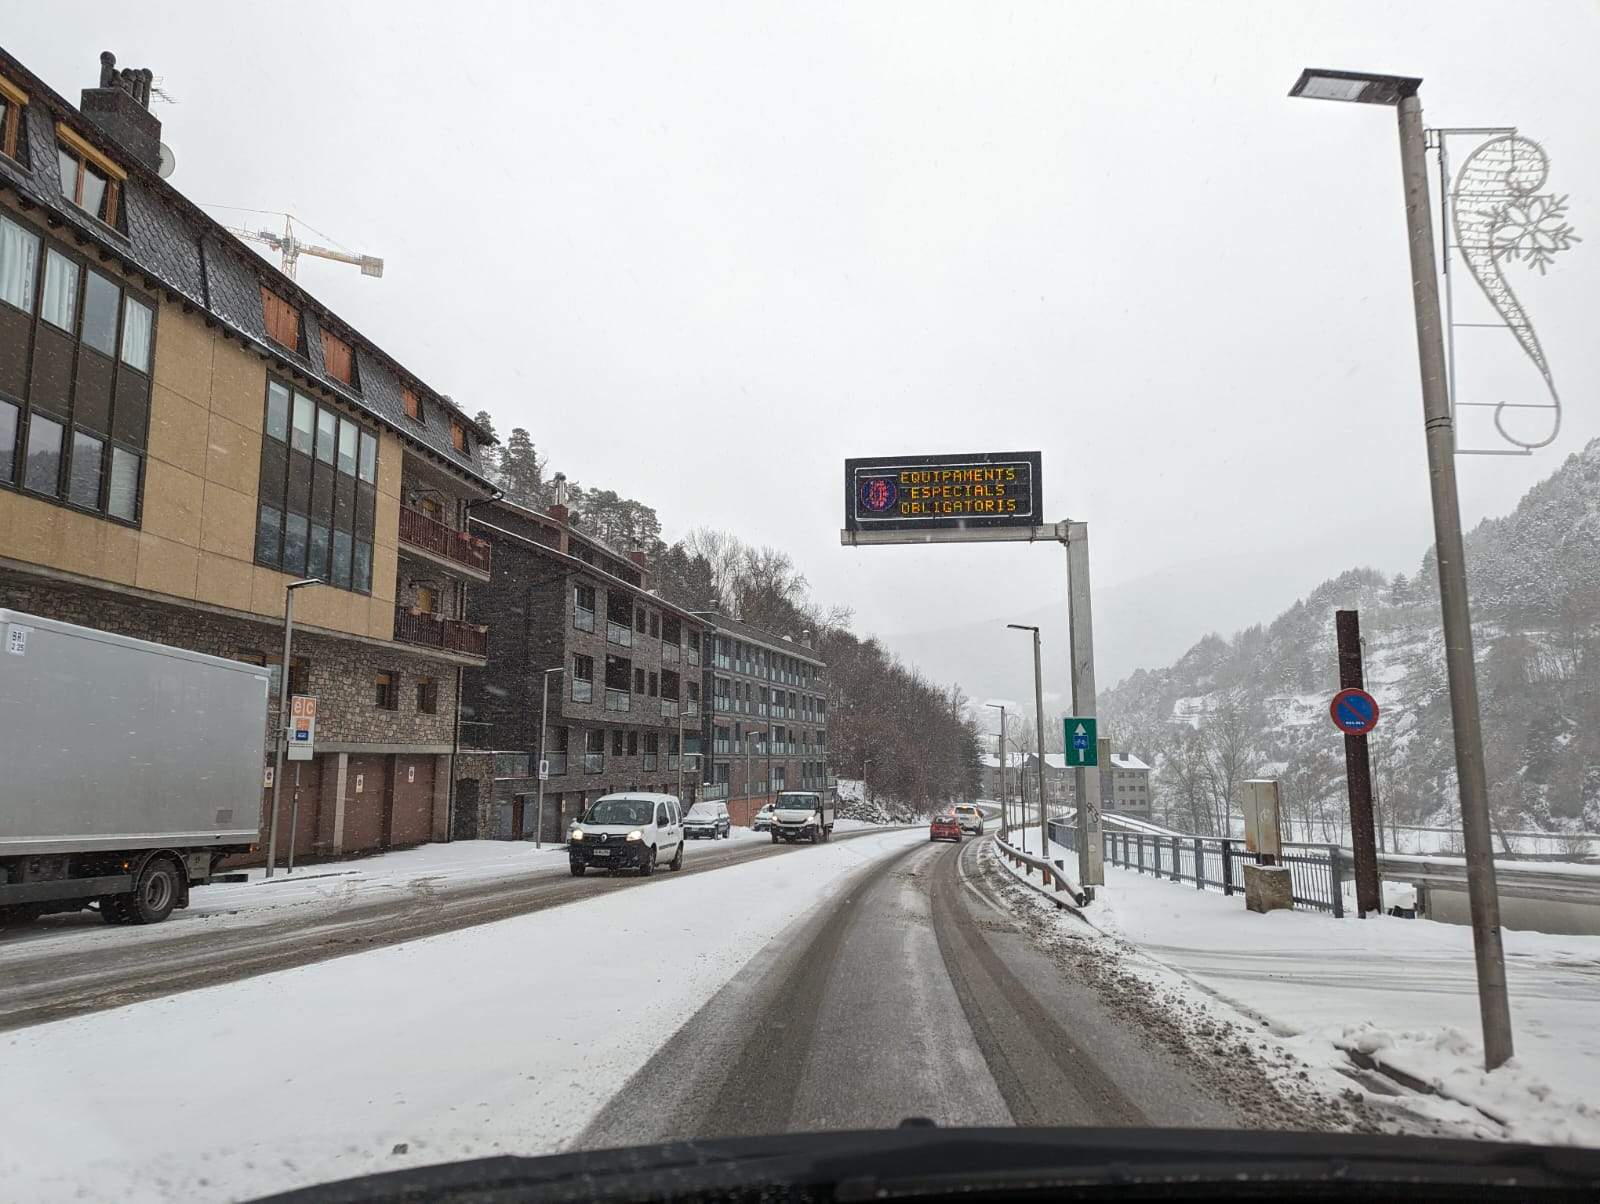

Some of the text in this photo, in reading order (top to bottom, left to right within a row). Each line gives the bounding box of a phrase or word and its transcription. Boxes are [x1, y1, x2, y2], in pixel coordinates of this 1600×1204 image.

[901, 469, 1015, 483] EQUIPAMENTS
[911, 485, 1005, 499] ESPECIALS
[901, 500, 1016, 514] OBLIGATORIS
